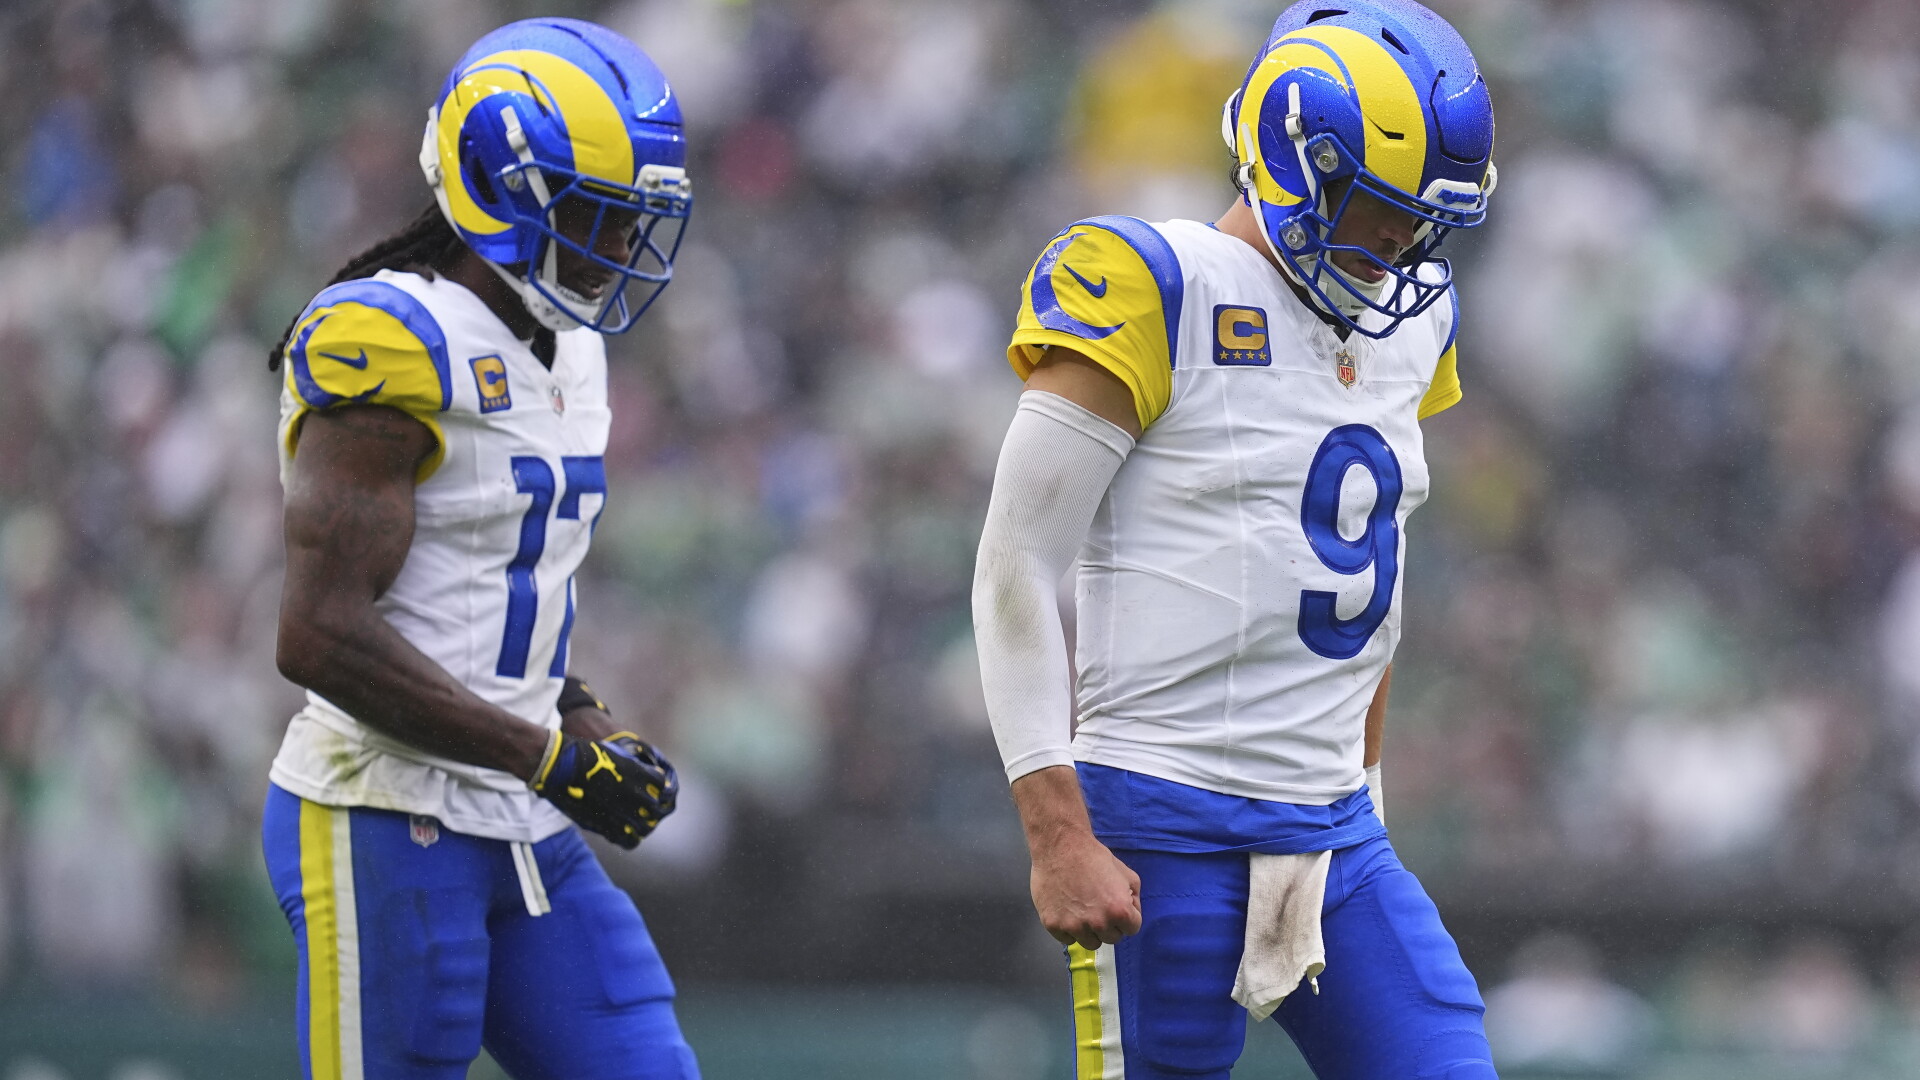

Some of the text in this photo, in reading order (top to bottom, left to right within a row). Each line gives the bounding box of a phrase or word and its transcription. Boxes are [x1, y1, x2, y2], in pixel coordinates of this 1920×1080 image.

[1218, 309, 1266, 350] C
[474, 357, 506, 398] C
[1340, 366, 1355, 381] NFL
[1298, 423, 1403, 660] 9
[496, 456, 608, 679] 17
